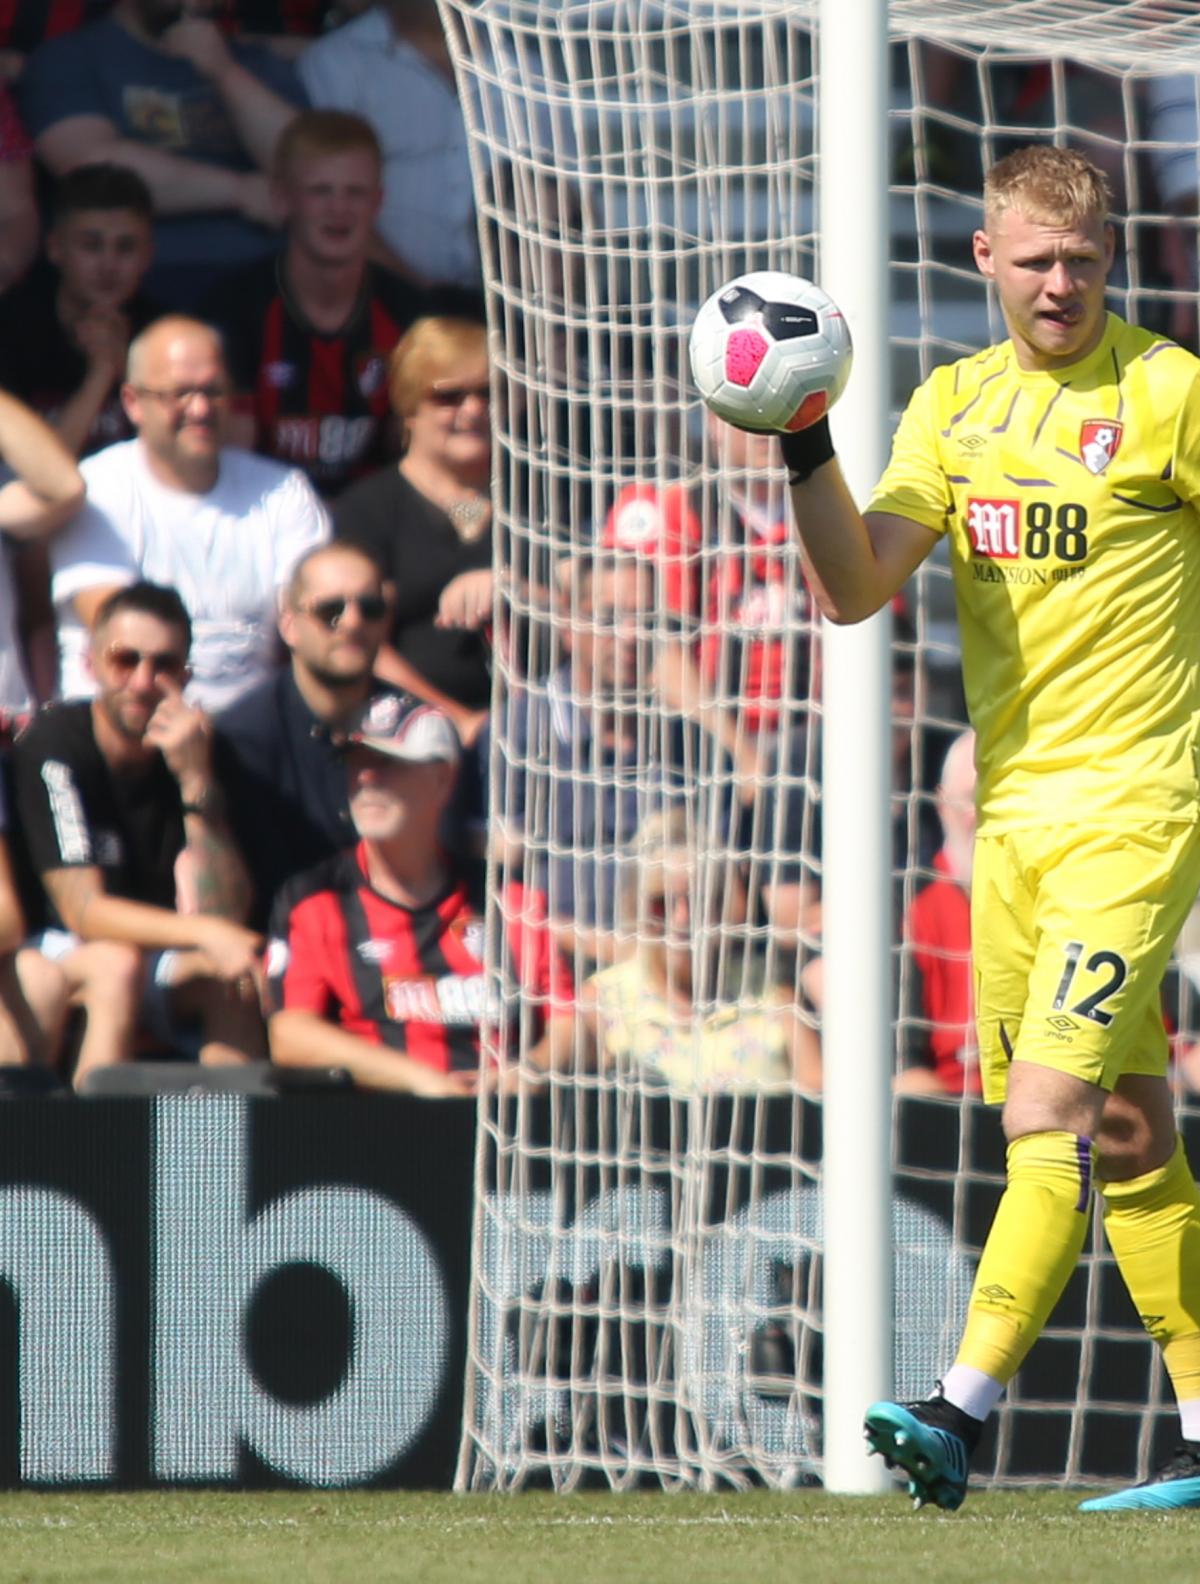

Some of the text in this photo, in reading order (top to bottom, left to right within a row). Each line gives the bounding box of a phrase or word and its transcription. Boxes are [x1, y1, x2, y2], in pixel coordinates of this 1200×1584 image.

[972, 563, 1048, 585] MANSION
[1052, 942, 1127, 1026] 12
[1043, 1030, 1074, 1043] umbro
